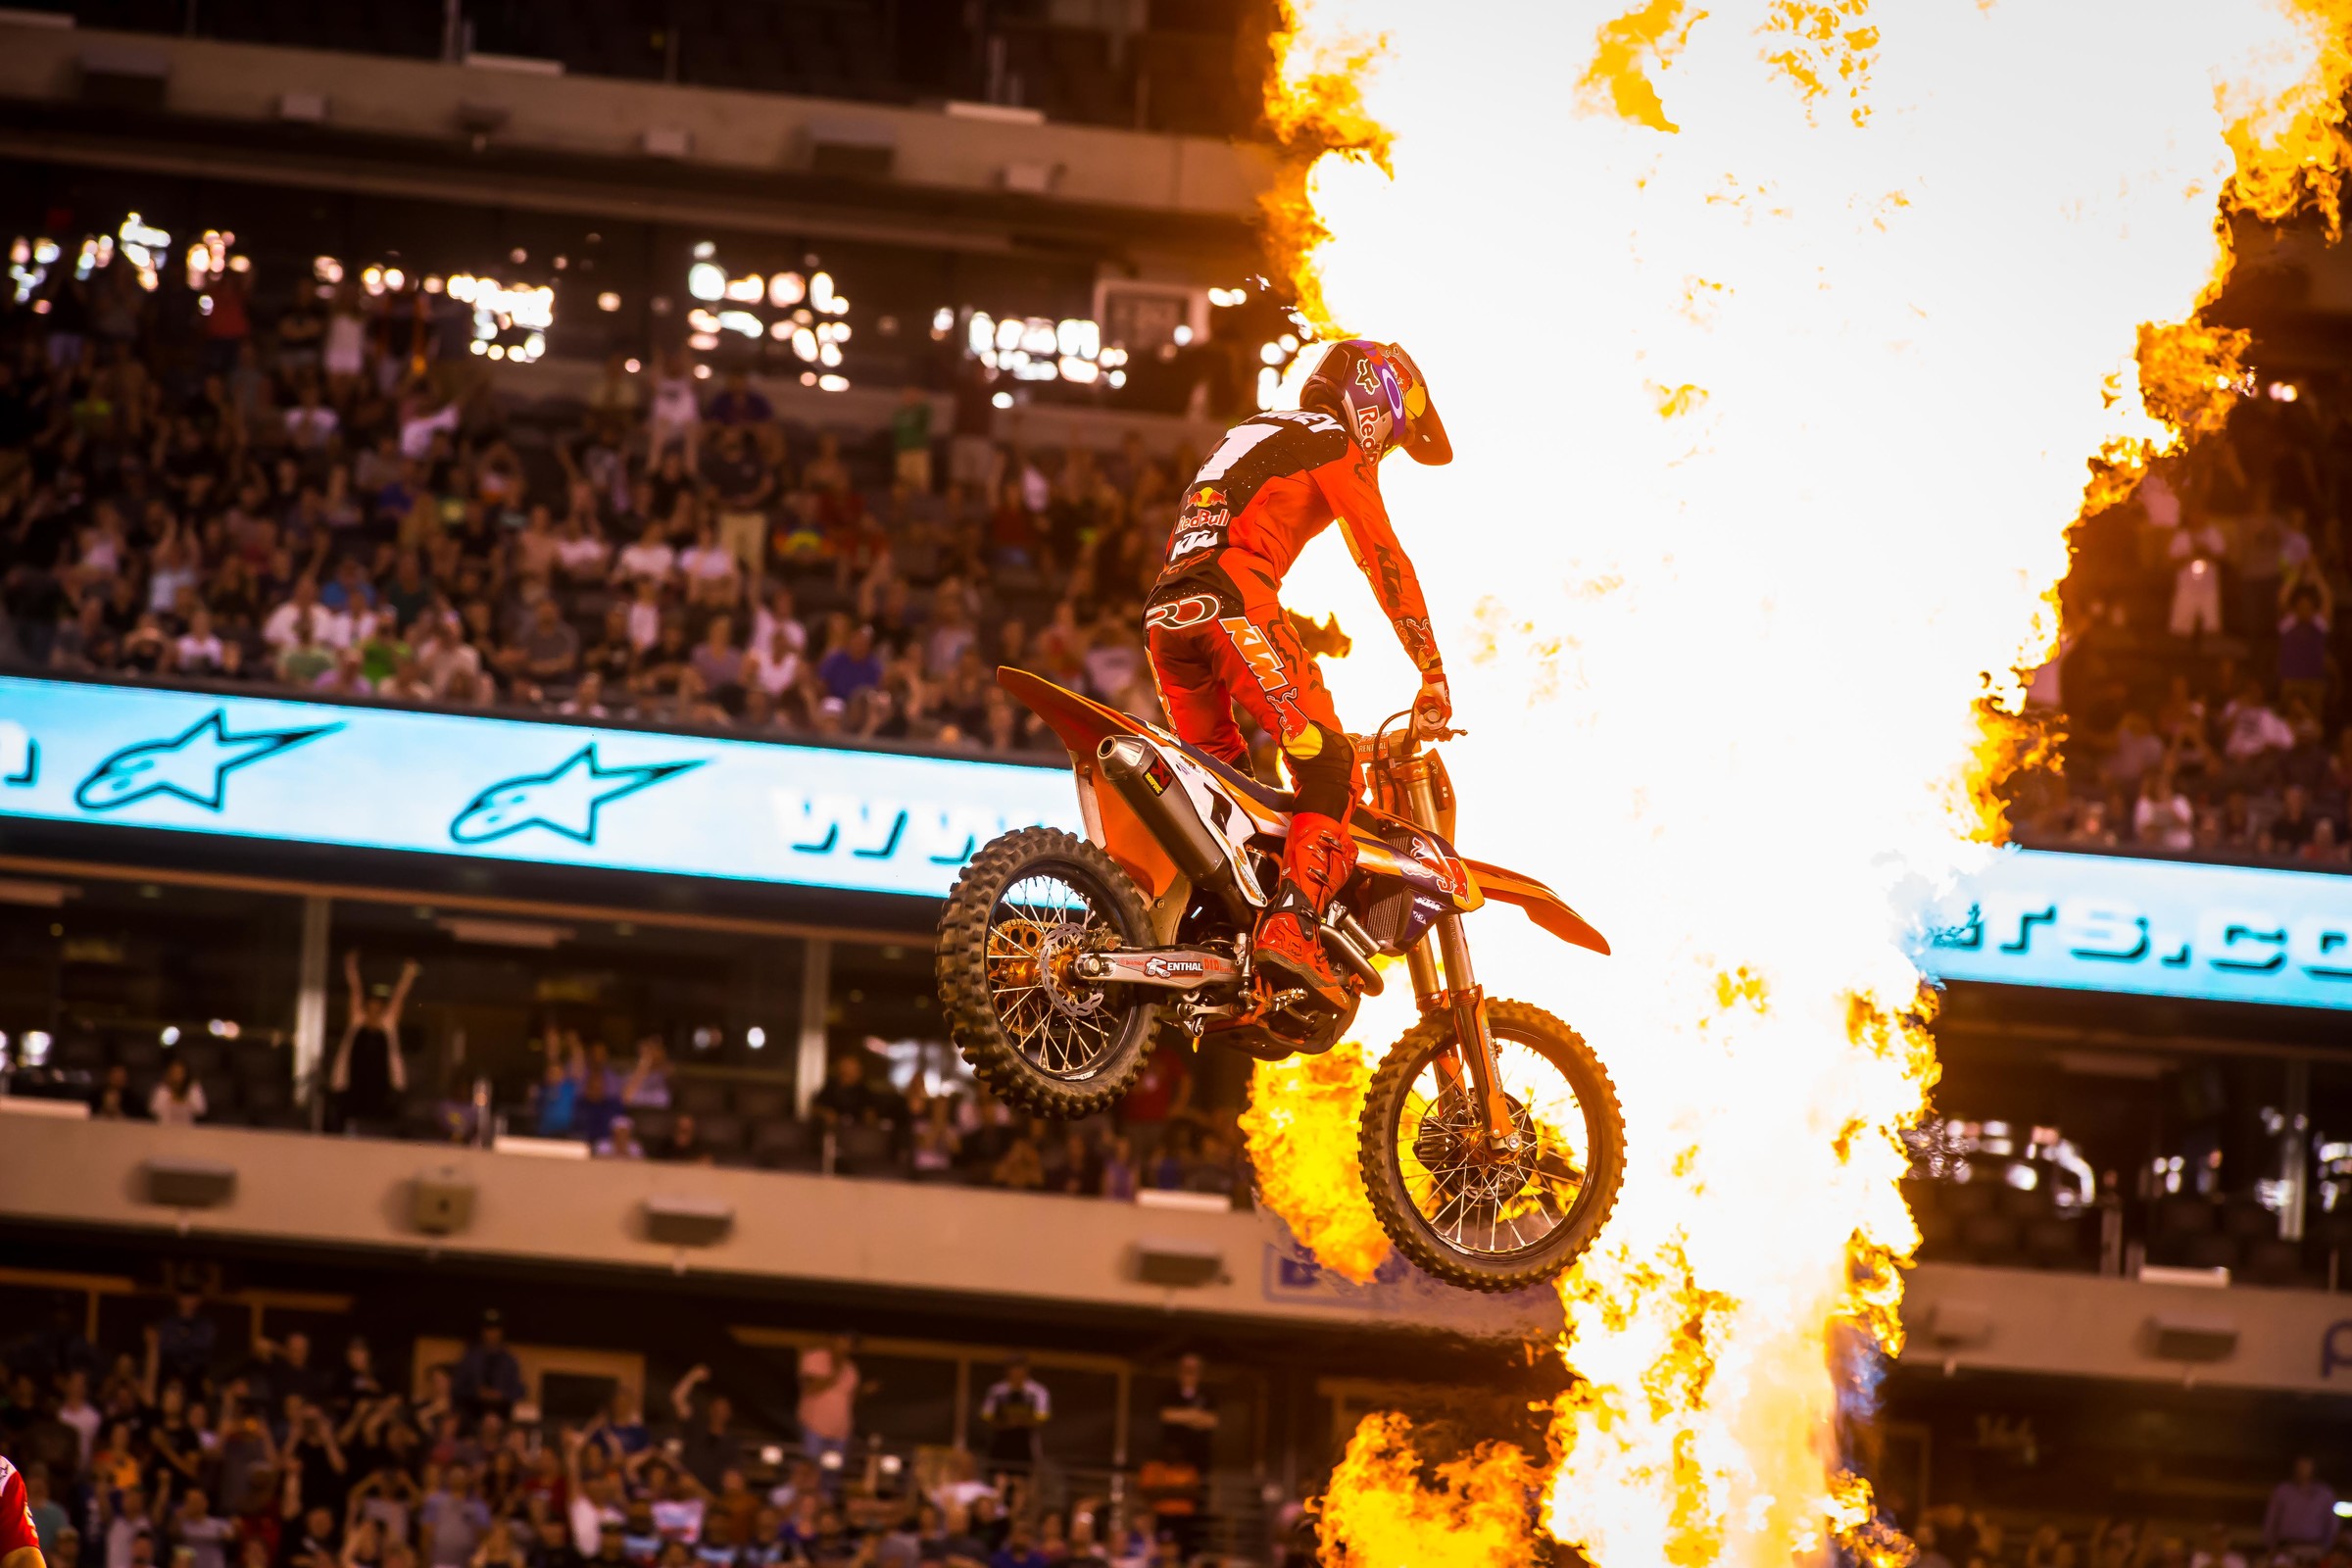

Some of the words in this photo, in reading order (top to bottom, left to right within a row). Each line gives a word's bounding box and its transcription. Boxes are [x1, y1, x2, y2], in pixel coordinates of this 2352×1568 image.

[1195, 423, 1284, 483] 1
[1170, 530, 1219, 562] KTM
[1218, 615, 1290, 693] KTM
[1358, 743, 1387, 753] RENTAL
[1927, 891, 2352, 981] rs.co
